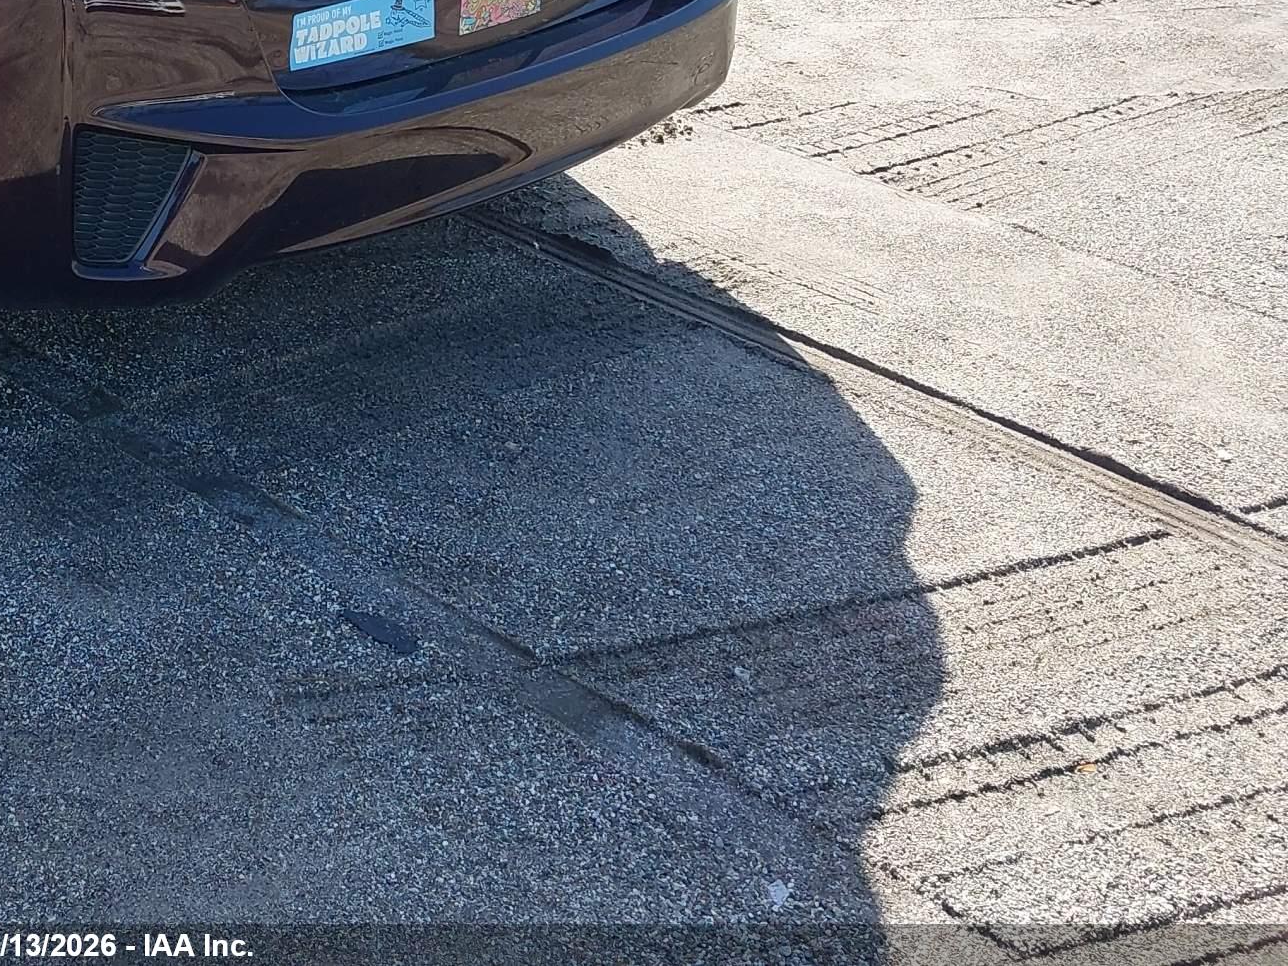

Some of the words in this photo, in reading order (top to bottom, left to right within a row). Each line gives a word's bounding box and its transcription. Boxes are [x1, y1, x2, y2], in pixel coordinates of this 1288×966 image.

[296, 17, 306, 28] I'M
[307, 10, 330, 25] PROUD
[332, 7, 341, 19] OF
[342, 5, 352, 17] MY
[296, 10, 381, 46] TADPOLE
[294, 33, 367, 64] WIZARD
